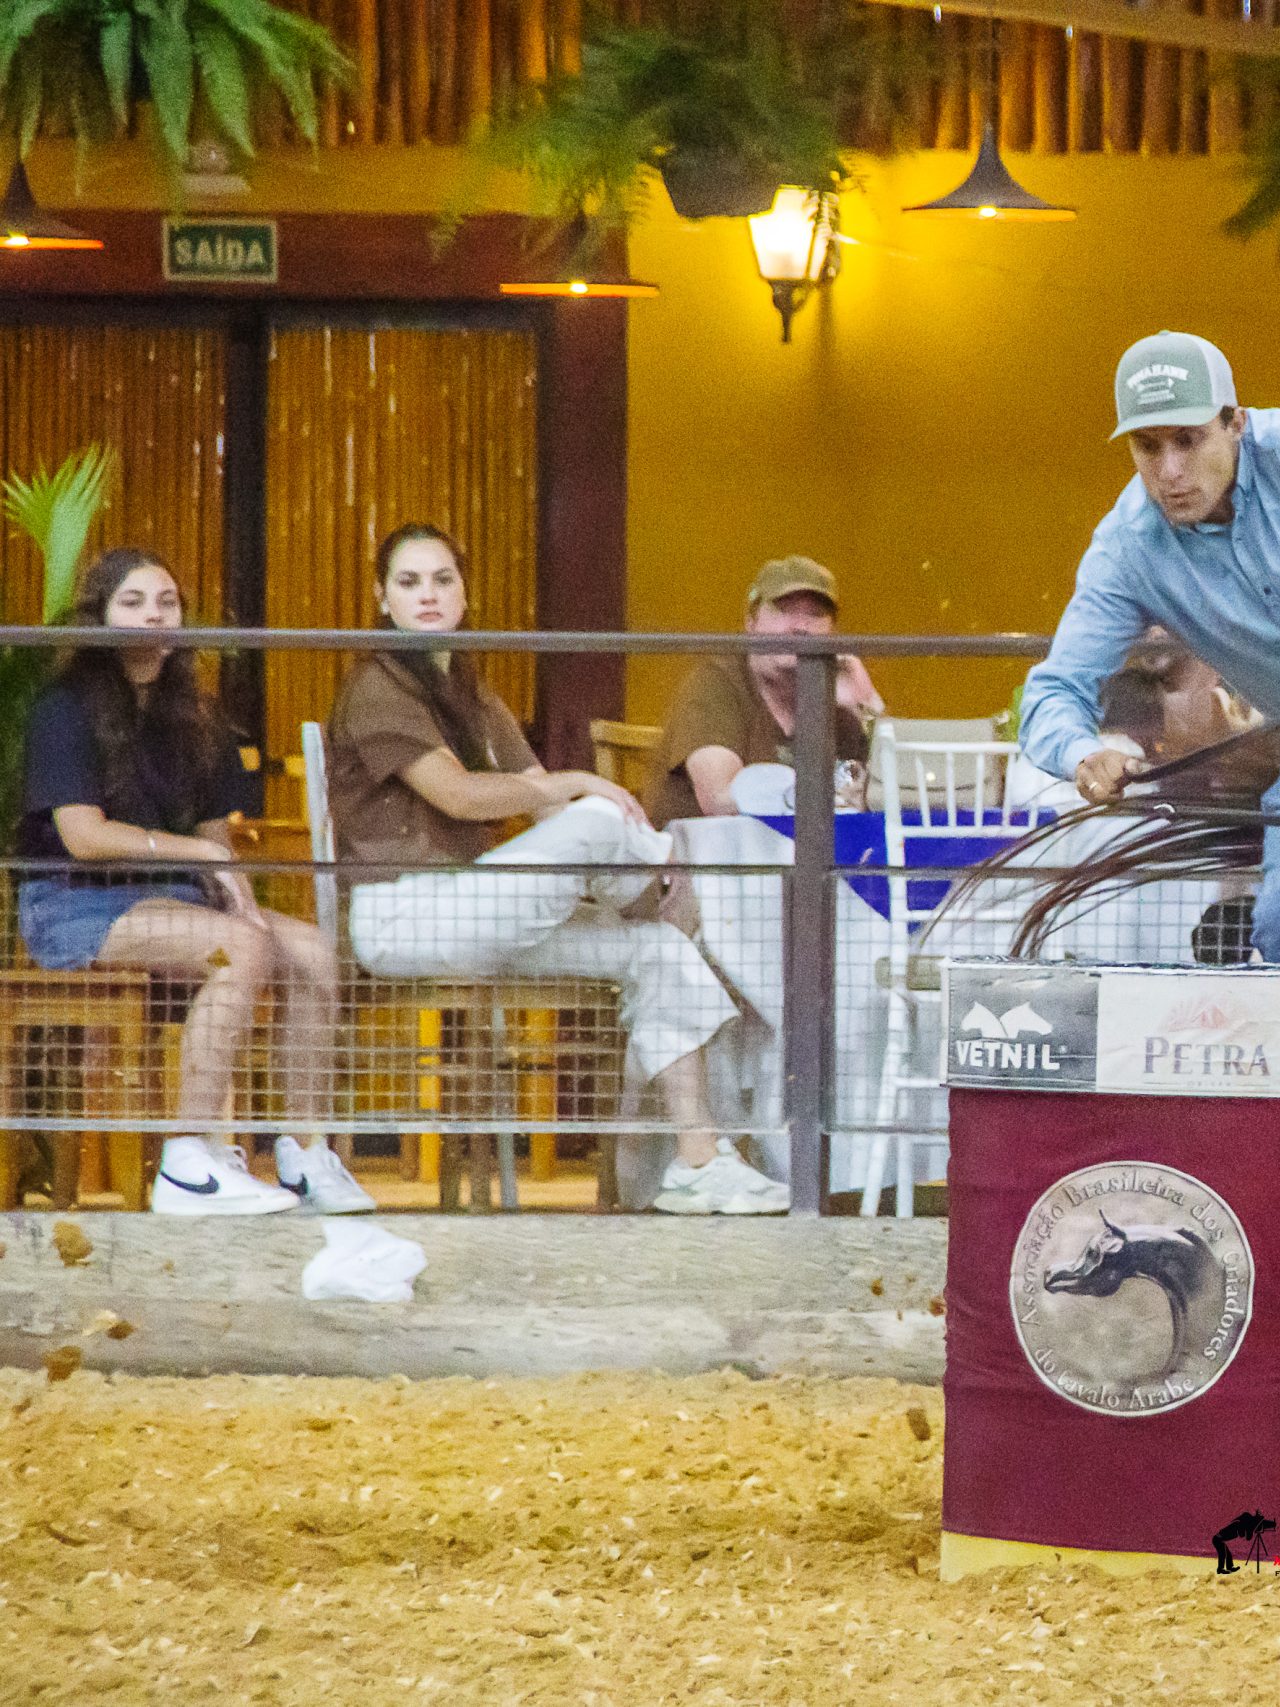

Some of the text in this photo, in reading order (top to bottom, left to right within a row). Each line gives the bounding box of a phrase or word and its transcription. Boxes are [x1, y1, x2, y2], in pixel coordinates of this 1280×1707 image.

[175, 234, 264, 264] SAÍDA
[956, 1039, 1060, 1071] VETNIL
[1144, 1036, 1271, 1077] PETRA
[1065, 1169, 1186, 1207] Brasileira
[1191, 1203, 1224, 1245] dos
[1203, 1251, 1246, 1361] Criadores
[1034, 1348, 1056, 1374] do
